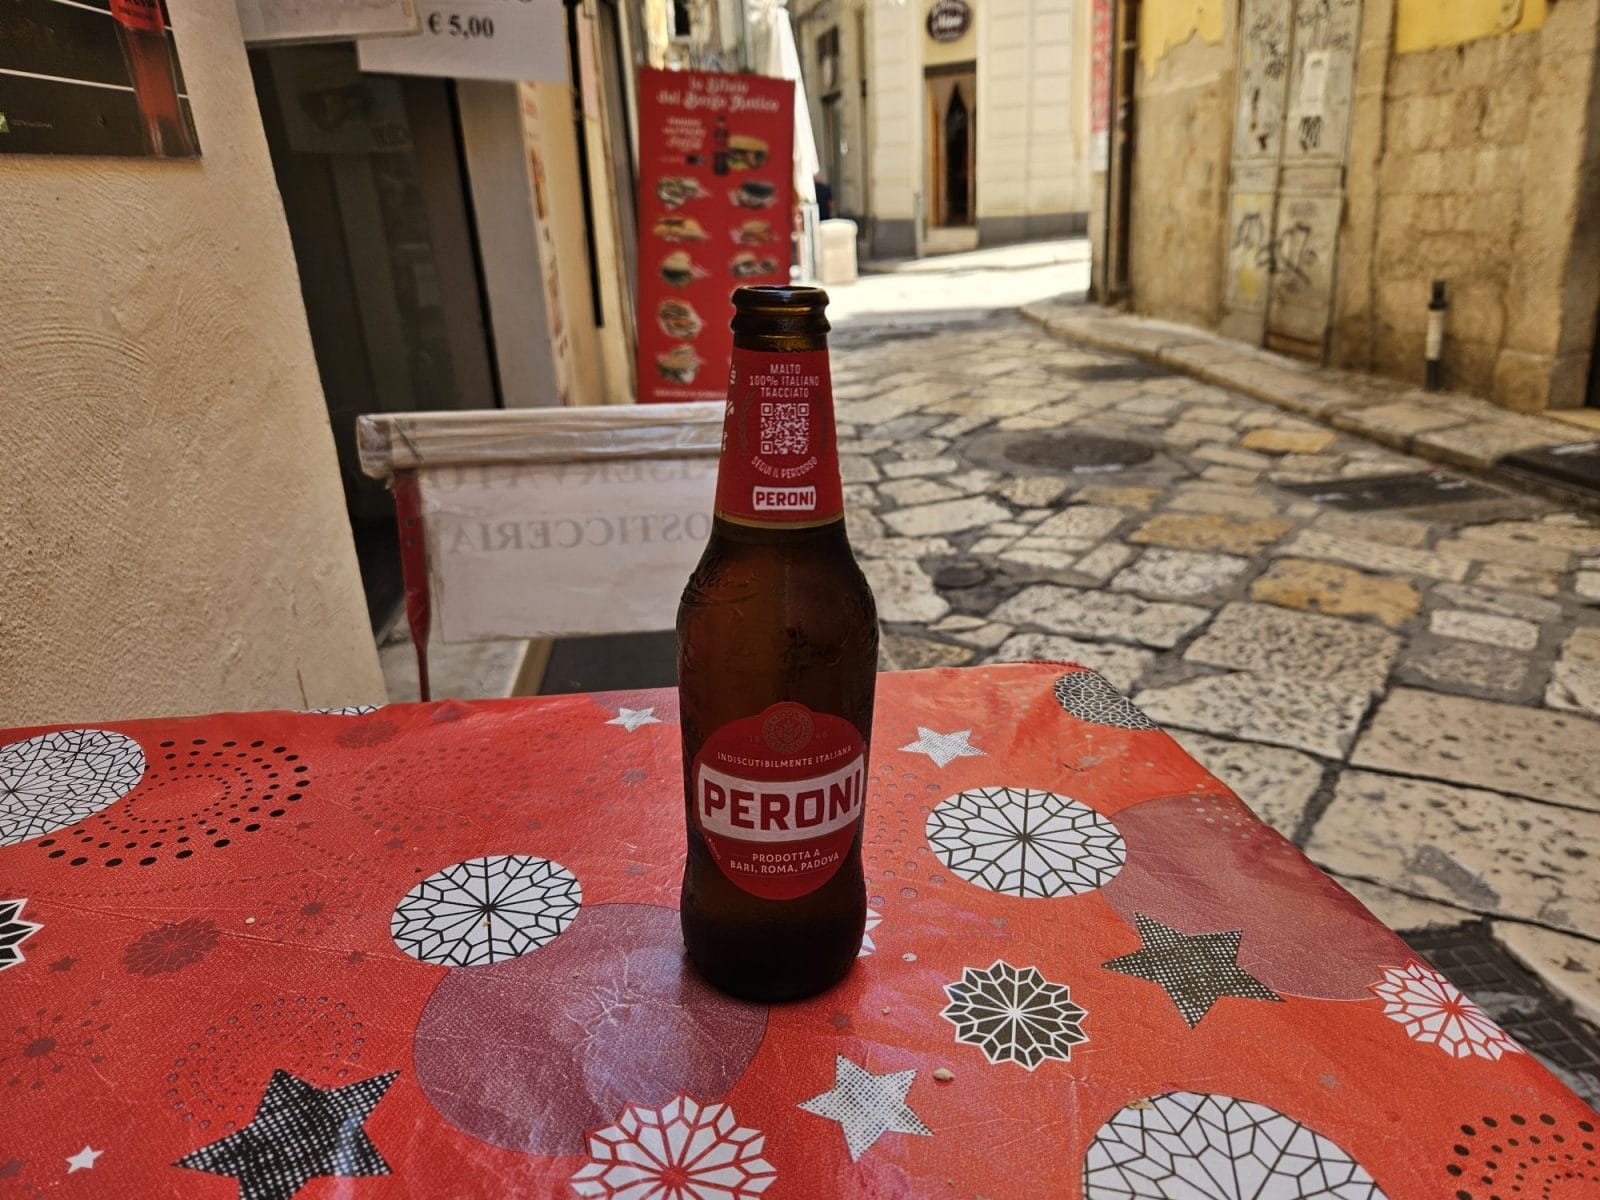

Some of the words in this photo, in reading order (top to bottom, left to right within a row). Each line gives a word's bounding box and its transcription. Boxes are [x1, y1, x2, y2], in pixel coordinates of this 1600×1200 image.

[428, 12, 443, 35] €
[449, 14, 495, 39] 5,00
[769, 363, 801, 375] MALTO
[748, 375, 779, 387] 100%
[781, 375, 820, 387] ITALIANO
[760, 387, 810, 399] TRACCIATO
[751, 455, 773, 476] SEGUI
[772, 467, 780, 479] IL
[781, 456, 818, 479] PERCORSO
[755, 491, 814, 506] PERONI
[717, 751, 814, 768] INDISCUTIBILMENTE
[815, 744, 852, 764] ITALIANA
[703, 767, 861, 831] PERONI
[751, 850, 811, 863] PRODOTTA
[812, 848, 821, 858] A
[799, 852, 839, 871] PADOVA
